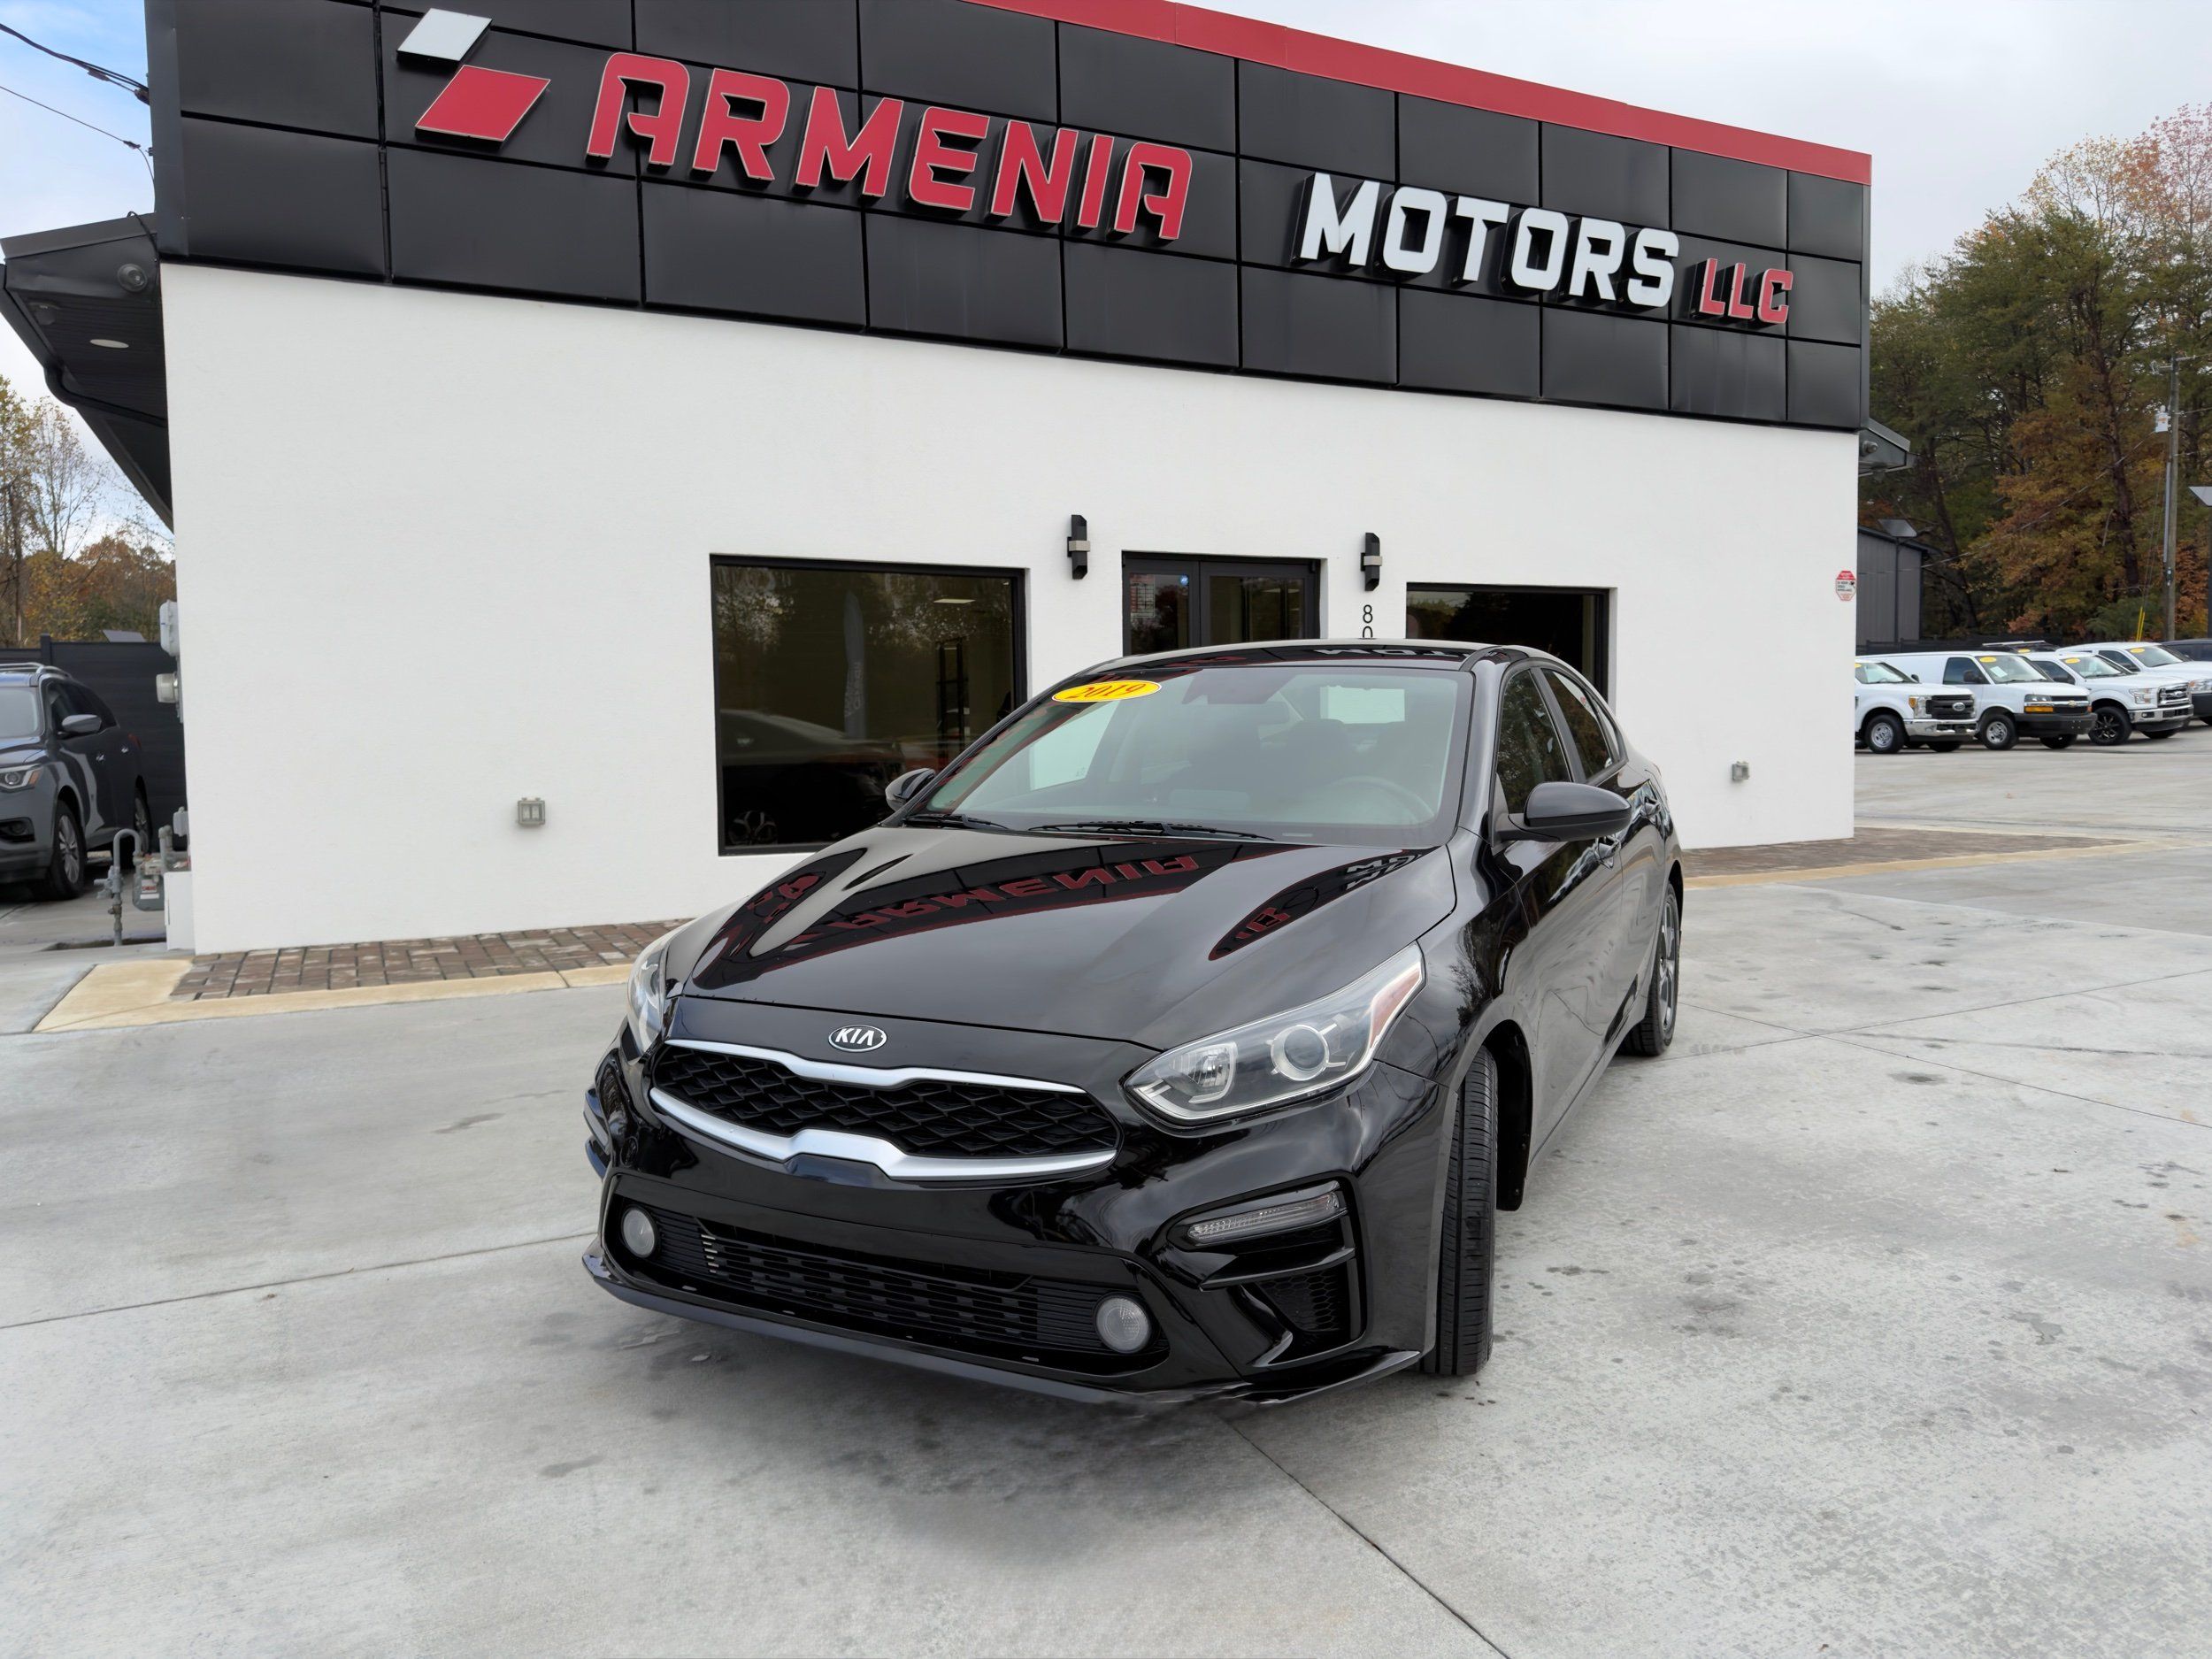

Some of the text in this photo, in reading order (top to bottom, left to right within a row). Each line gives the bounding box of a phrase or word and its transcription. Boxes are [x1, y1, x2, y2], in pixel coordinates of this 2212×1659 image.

[586, 52, 1793, 324] ARMENIA MOTORS LLC
[1065, 683, 1147, 699] 2019
[834, 1027, 875, 1047] KIA
